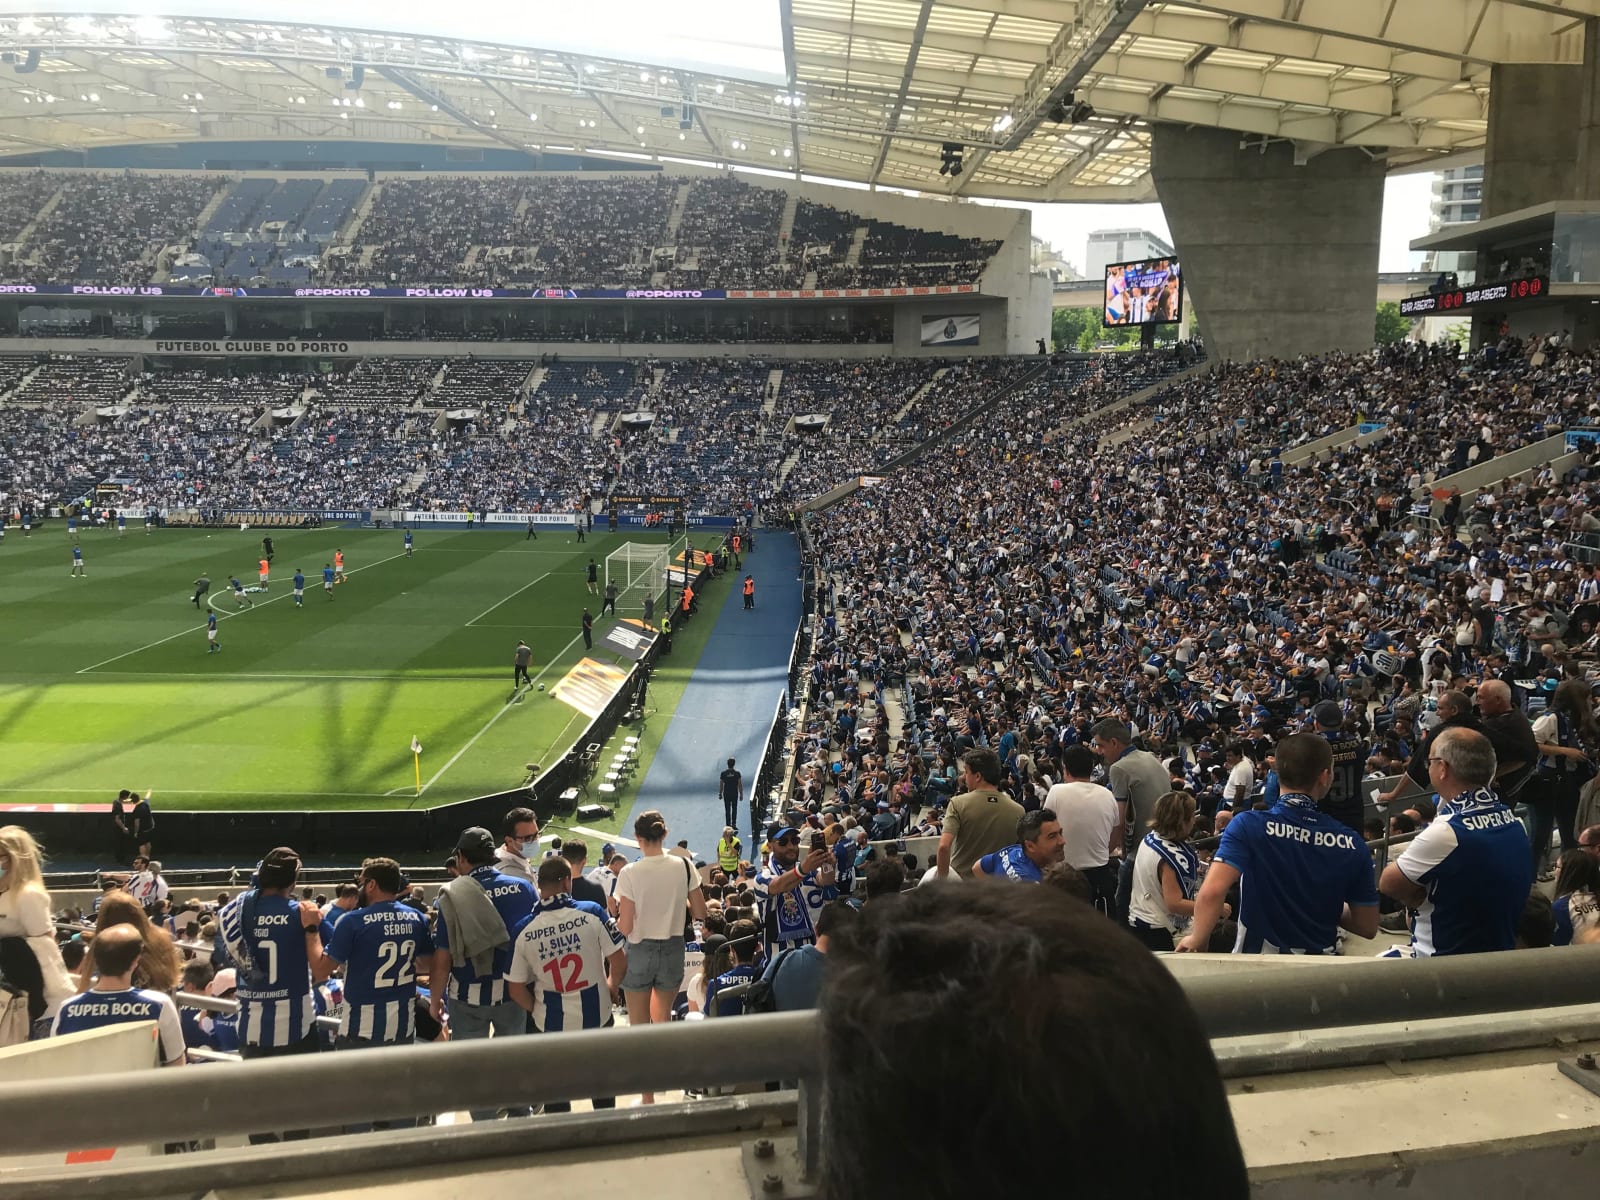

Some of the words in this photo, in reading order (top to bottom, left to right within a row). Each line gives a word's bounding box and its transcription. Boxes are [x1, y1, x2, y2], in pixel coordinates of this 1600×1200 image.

[73, 286, 136, 294] FOLLOW
[140, 287, 162, 295] US
[295, 288, 371, 296] @FCPORTO
[406, 289, 467, 297] FOLLOW
[472, 289, 493, 297] US
[625, 290, 702, 298] @FCPORTO
[156, 341, 220, 352] FUTEBOL
[225, 342, 271, 352] CLUBE
[276, 342, 296, 353] DO
[301, 342, 348, 353] PORTO
[1462, 812, 1504, 831] SUPER
[1266, 821, 1310, 844] SUPER
[1314, 831, 1356, 850] BOCK
[494, 884, 521, 897] BOCK
[258, 915, 289, 926] BOCK
[363, 911, 395, 925] SUPER
[396, 911, 420, 922] BOCK
[384, 922, 413, 936] SÉRGIO
[525, 926, 556, 942] SUPER
[558, 915, 589, 933] BOCK
[538, 942, 548, 953] J.
[550, 933, 581, 949] SILVA
[374, 940, 416, 989] 22
[543, 953, 589, 994] 12
[721, 976, 749, 985] SUPER
[67, 1003, 108, 1018] SUPER
[112, 1002, 151, 1016] BOCK
